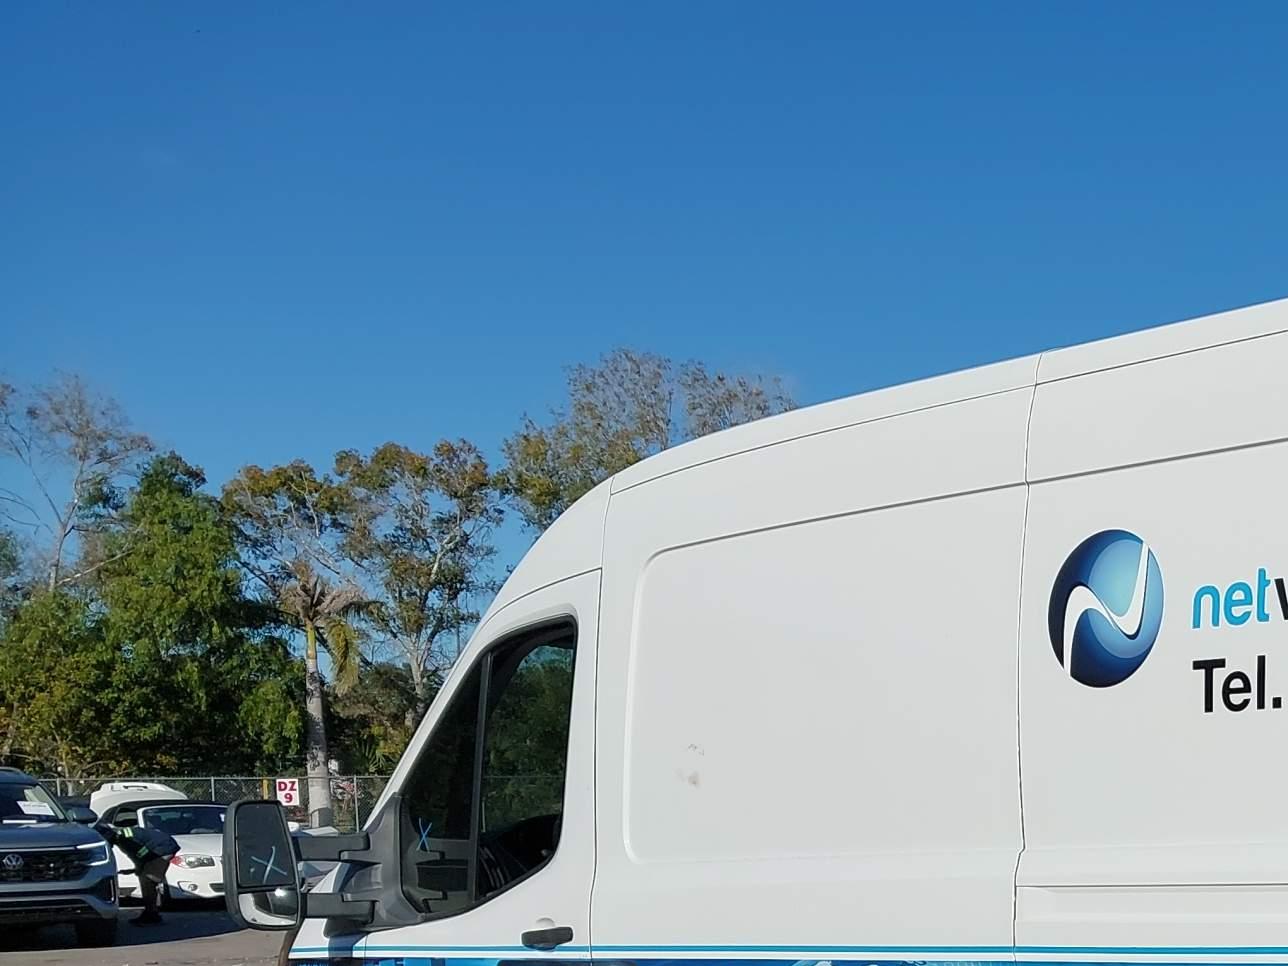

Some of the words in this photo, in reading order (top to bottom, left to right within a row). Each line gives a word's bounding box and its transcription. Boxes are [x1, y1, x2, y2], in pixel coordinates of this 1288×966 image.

[1192, 654, 1283, 713] Tel.
[277, 781, 297, 792] DZ
[284, 792, 293, 803] 9
